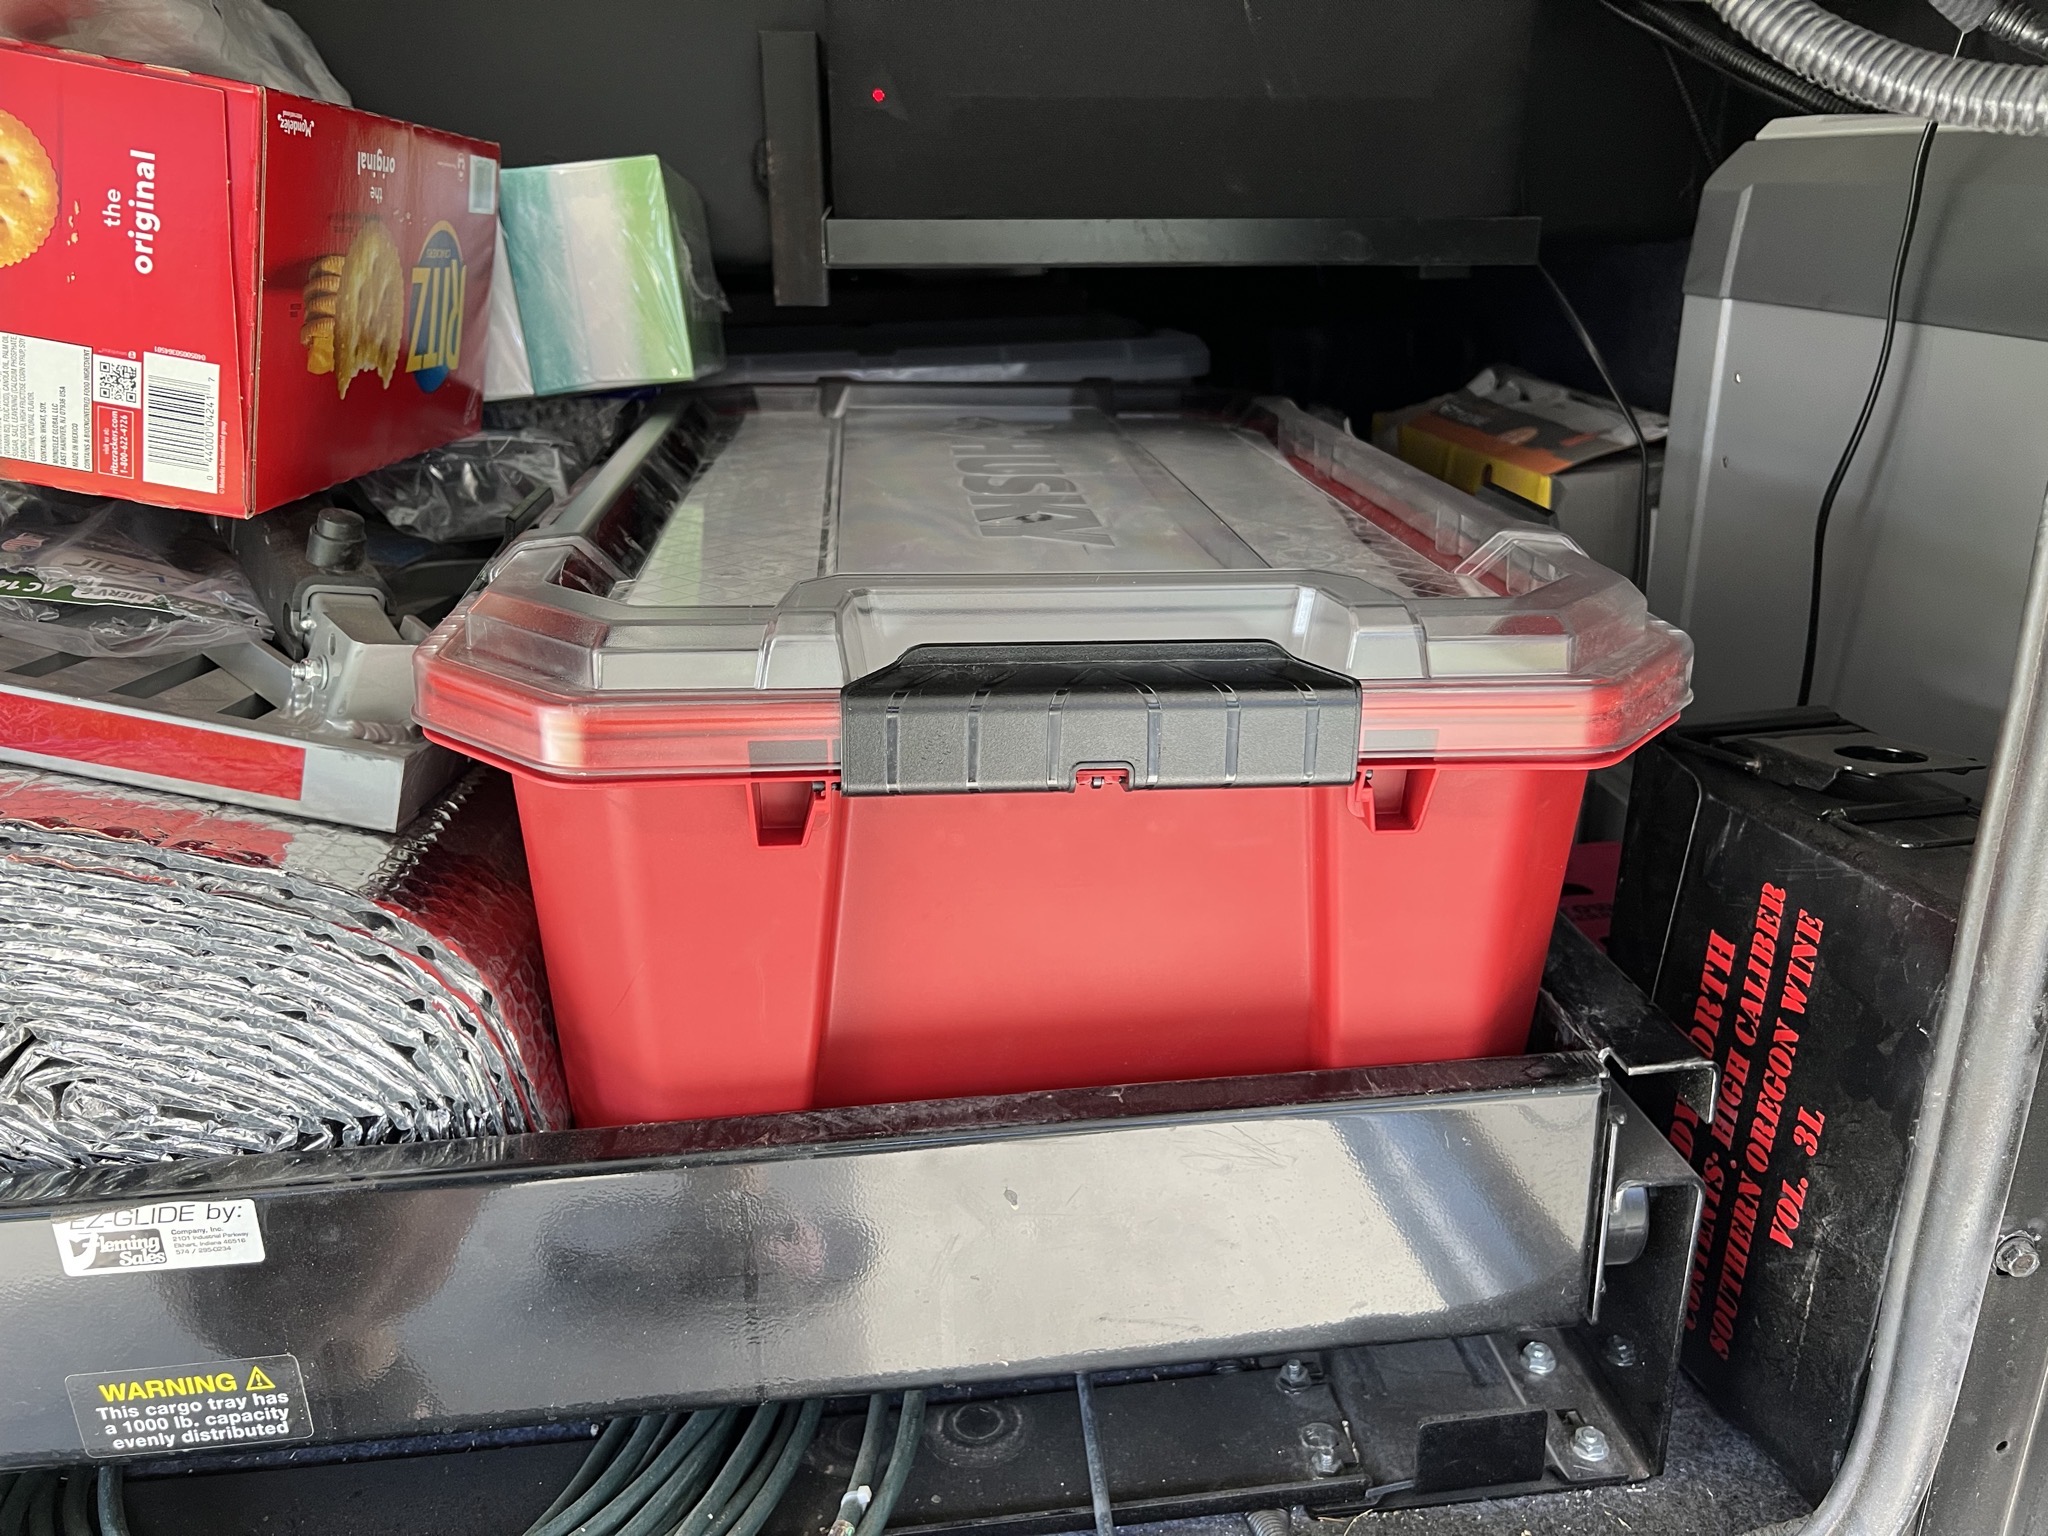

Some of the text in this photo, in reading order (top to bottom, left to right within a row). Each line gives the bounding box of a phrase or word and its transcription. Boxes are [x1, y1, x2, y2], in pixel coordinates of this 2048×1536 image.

[357, 148, 396, 179] original
[102, 188, 121, 227] the
[370, 186, 383, 204] the
[128, 149, 160, 274] original
[405, 259, 467, 373] RITZ
[206, 396, 215, 427] 04241
[71, 423, 79, 444] MEXICO
[109, 411, 118, 475] ritzcrackers.com
[120, 415, 128, 473] 1-800-622-4726
[205, 432, 215, 463] 44000
[1711, 1046, 1750, 1151] HIGH
[1734, 882, 1787, 1047] CALIBER
[1709, 908, 1824, 1361] SOUTHERN OREGON WINE
[1769, 1106, 1826, 1250] VOL. 3L
[206, 1203, 242, 1223] by:
[170, 1228, 209, 1236] Company,
[118, 1247, 167, 1266] Sales
[98, 1373, 238, 1402] WARNING
[95, 1391, 290, 1421] This cargo tray has
[104, 1406, 290, 1436] a 1000 lb. capacity
[112, 1421, 290, 1450] evenly distributed
